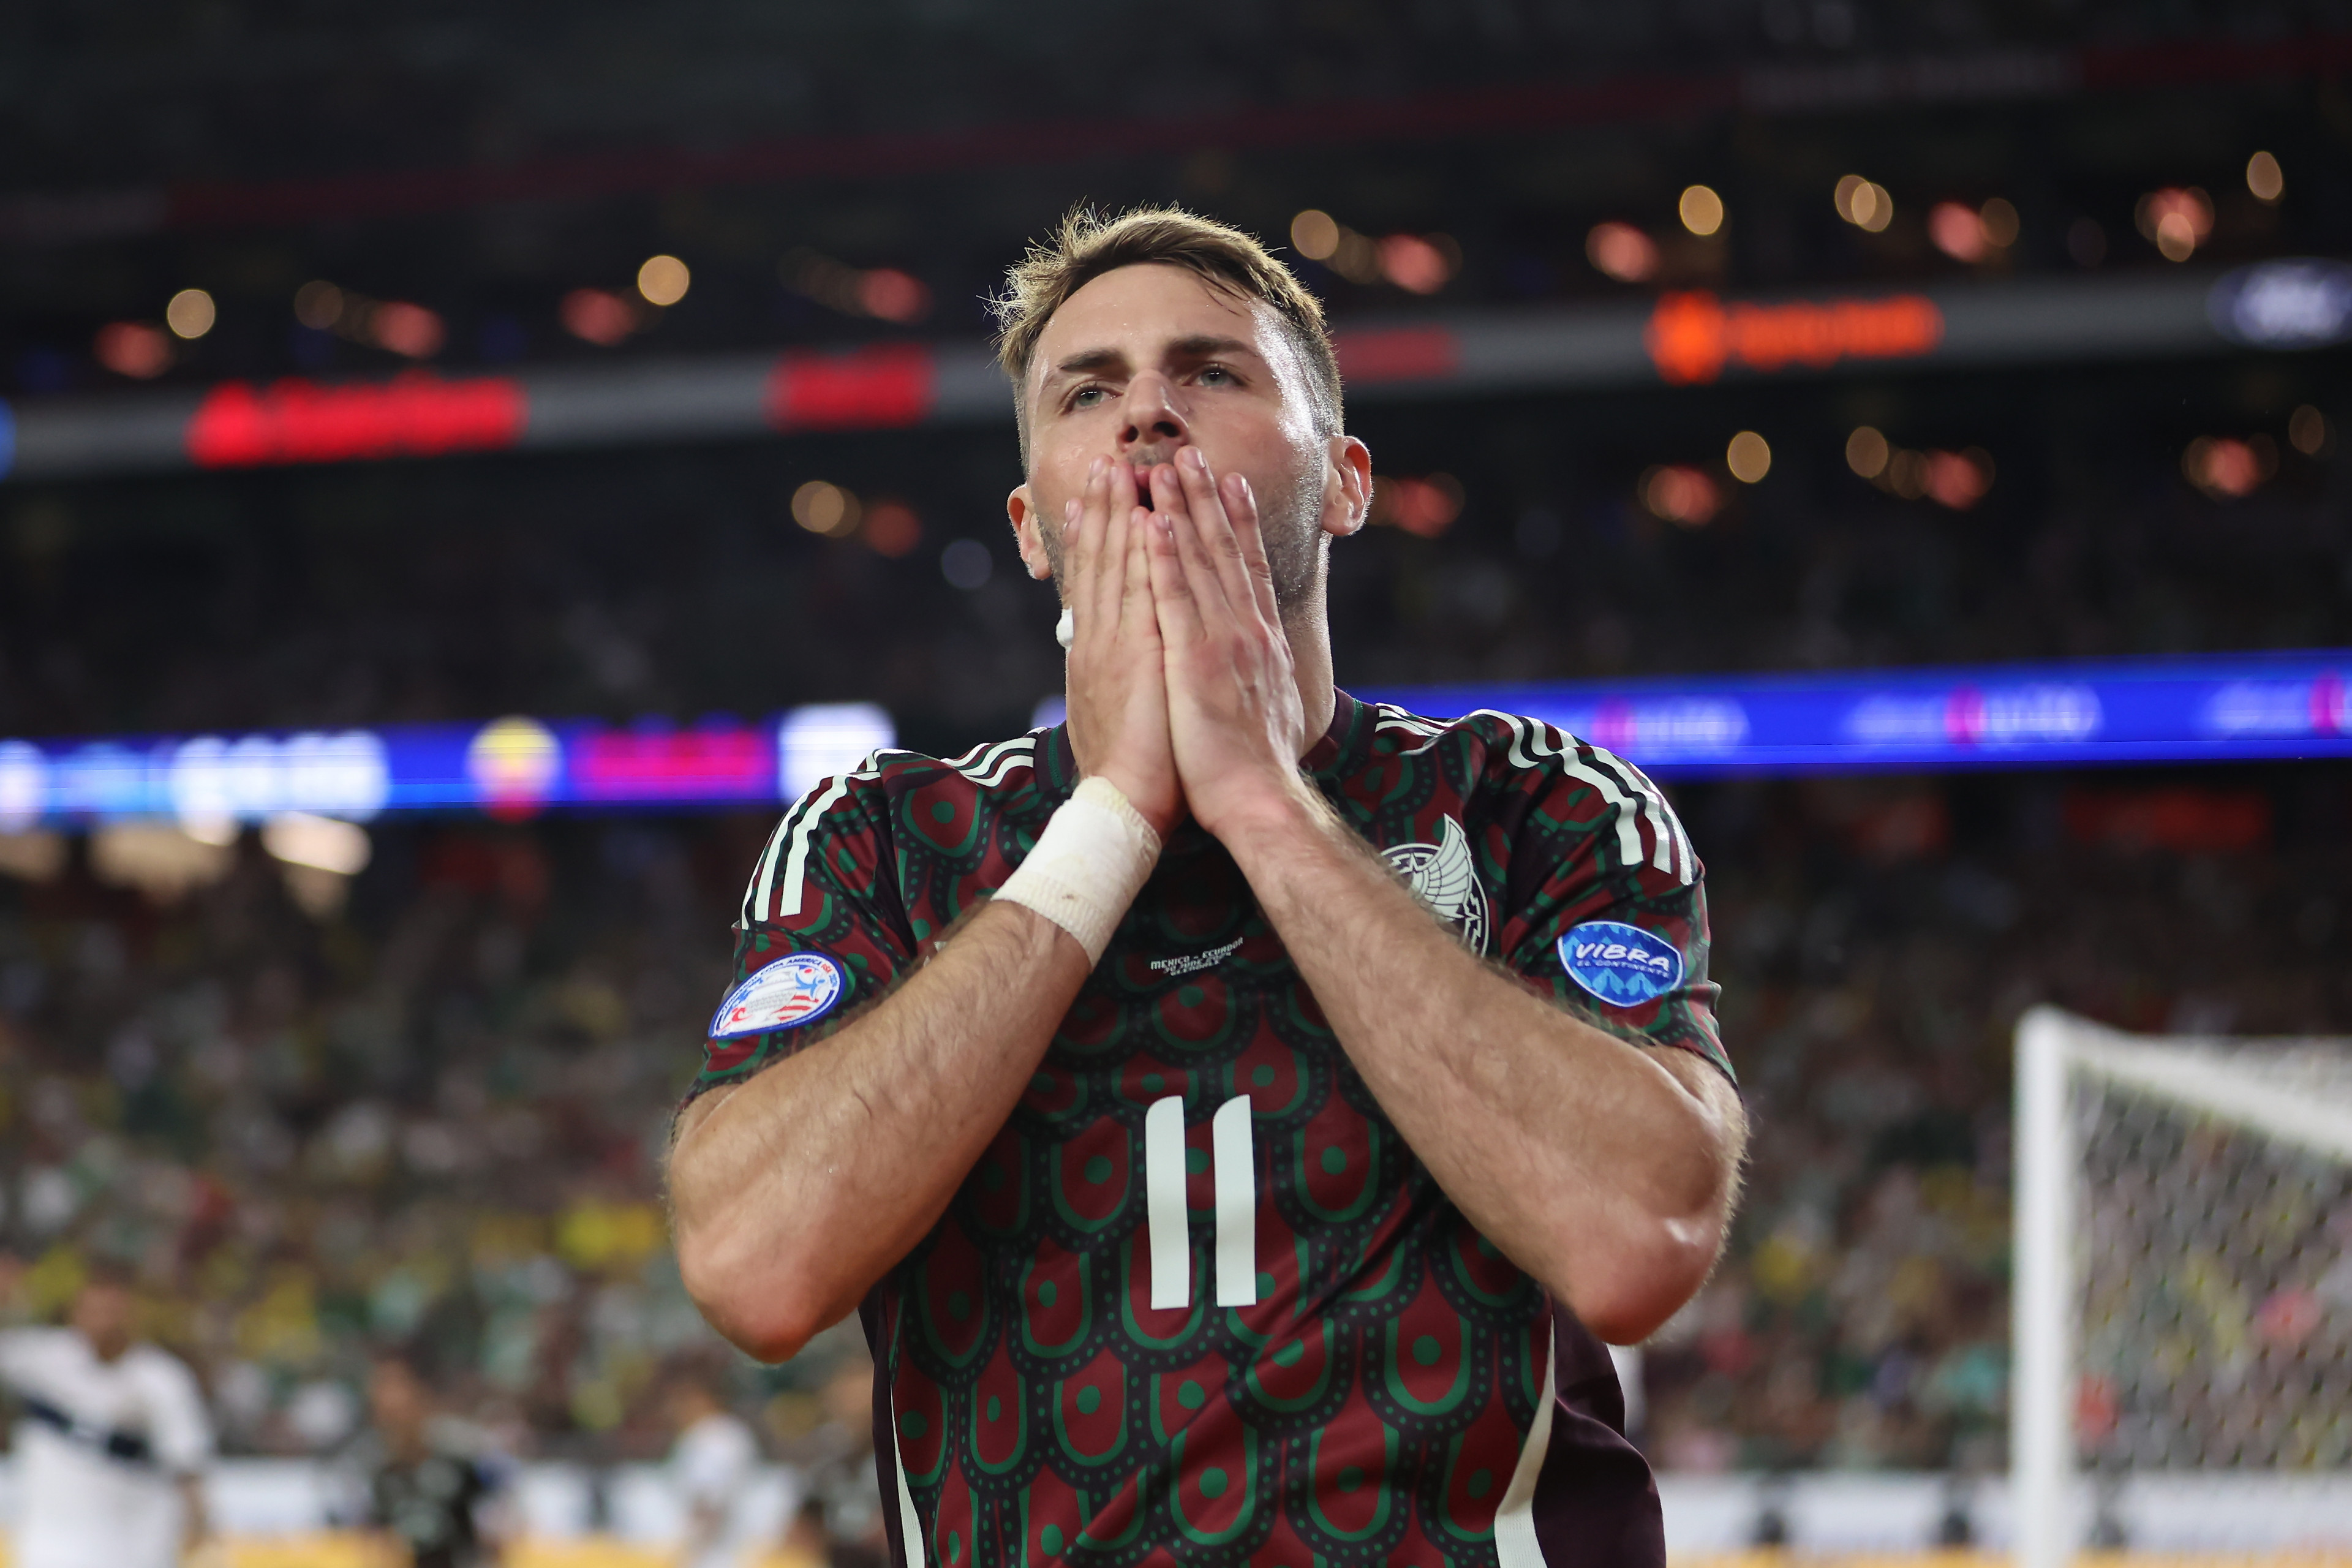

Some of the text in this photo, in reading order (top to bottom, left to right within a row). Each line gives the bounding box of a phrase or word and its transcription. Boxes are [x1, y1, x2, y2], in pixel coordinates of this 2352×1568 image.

[1202, 936, 1243, 959] ECUADOR
[1576, 943, 1670, 972] VIBRA
[1145, 1094, 1256, 1310] 11
